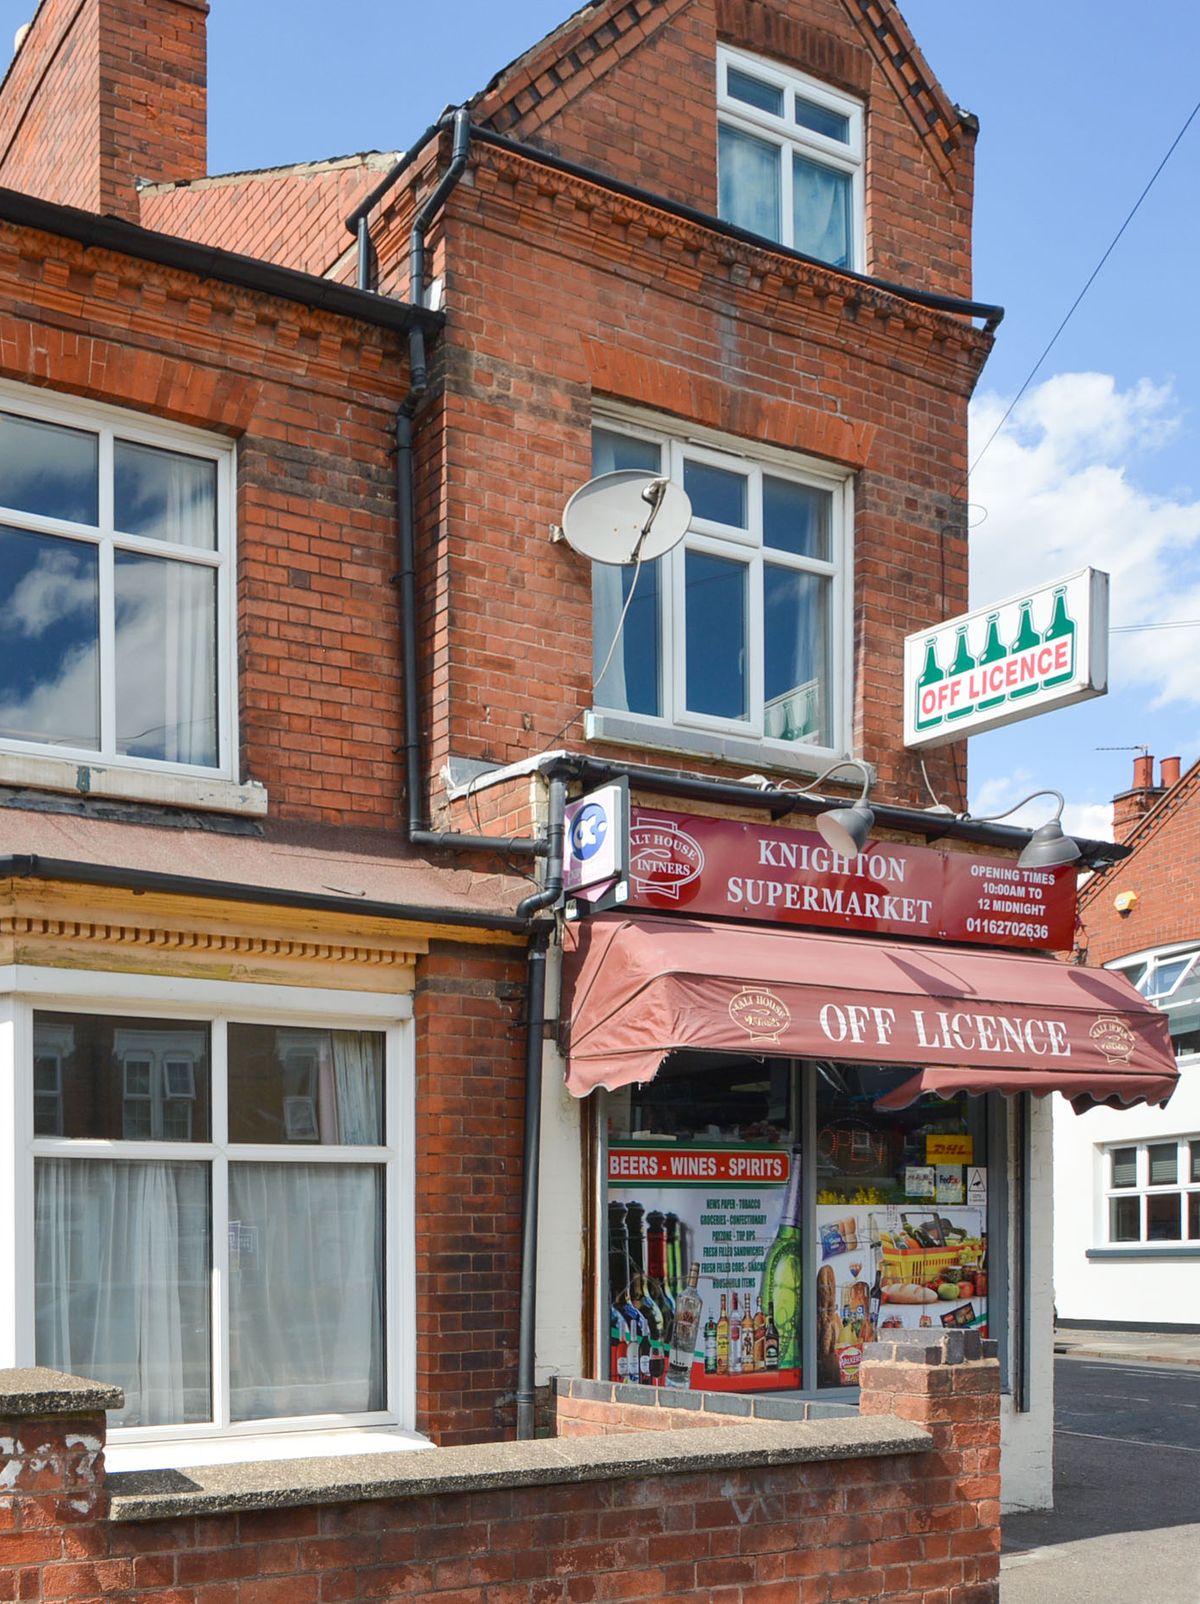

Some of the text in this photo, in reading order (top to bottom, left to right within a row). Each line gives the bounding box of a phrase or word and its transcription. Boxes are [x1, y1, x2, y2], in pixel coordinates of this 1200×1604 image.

[921, 641, 1068, 715] OFF LICENCE
[654, 834, 697, 861] HOUSE
[758, 839, 907, 883] KNIGHTON
[970, 864, 1056, 885] OPENING TIMES
[727, 876, 933, 924] SUPERMARKET
[982, 882, 1043, 899] 10:00AM TO
[978, 898, 1046, 916] 12 MIDNIGHT
[966, 917, 1049, 939] 01162702636
[819, 1003, 1071, 1056] OFF LICENCE
[932, 1143, 968, 1155] DHL
[609, 1155, 782, 1177] BEERS WINES SPIRITS
